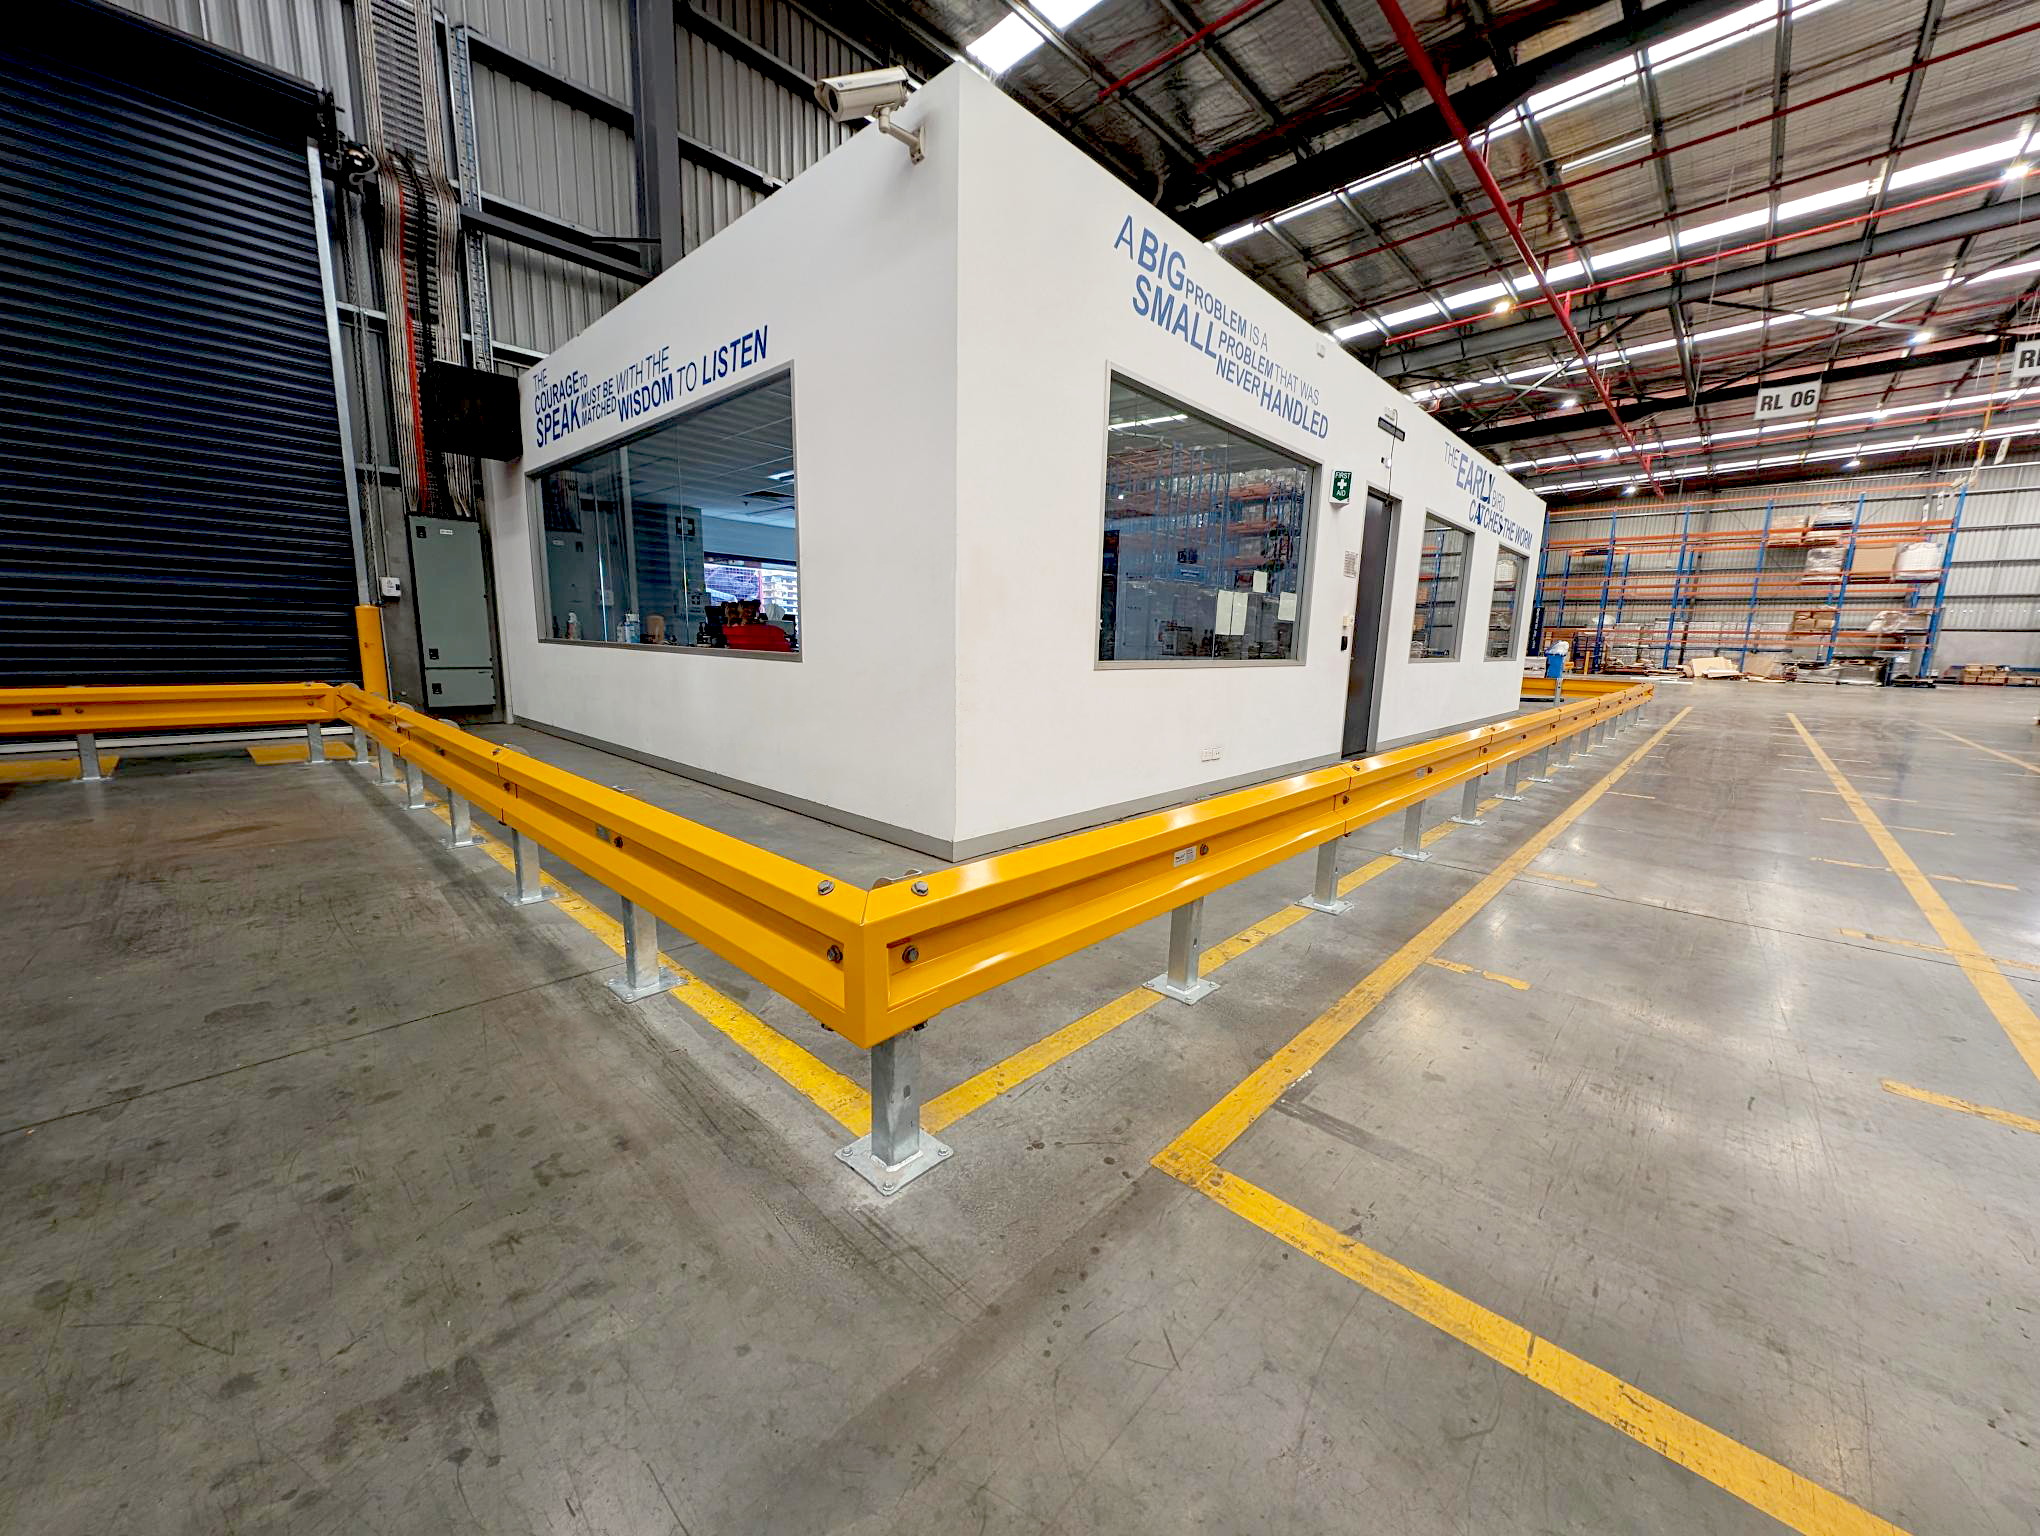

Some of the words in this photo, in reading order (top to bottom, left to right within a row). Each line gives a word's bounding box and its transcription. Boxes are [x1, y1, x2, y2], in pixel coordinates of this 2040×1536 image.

[1114, 215, 1133, 260] A
[1137, 227, 1187, 292] BIG
[1186, 278, 1247, 338] PROBLEM
[1249, 322, 1260, 346] IS
[1260, 332, 1269, 353] A
[1132, 275, 1217, 360] SMALL
[1217, 330, 1274, 380] PROBLEM
[1275, 363, 1299, 393] THAT
[1300, 379, 1320, 406] WAS
[533, 368, 548, 392] THE
[535, 370, 580, 415] COURAGE
[580, 374, 588, 391] TO
[581, 396, 617, 427] MATCHED
[618, 373, 673, 422] WISDOM
[677, 362, 698, 396] TO
[702, 325, 768, 385] LISTEN
[581, 385, 601, 409] MUST
[603, 377, 614, 398] BE
[616, 359, 643, 395] WITH
[645, 346, 670, 380] THE
[1216, 354, 1261, 398] NEVER
[1260, 381, 1329, 439] HANDLED
[1760, 393, 1784, 411] RL
[1791, 389, 1816, 408] 06
[536, 396, 581, 448] SPEAK
[1335, 471, 1352, 480] FIRST
[1336, 489, 1346, 497] AID
[1444, 441, 1460, 470] THE
[1456, 453, 1496, 504] EARLY
[1469, 499, 1503, 535] CATCHES
[1502, 517, 1515, 541] THE
[1515, 527, 1532, 550] WORM
